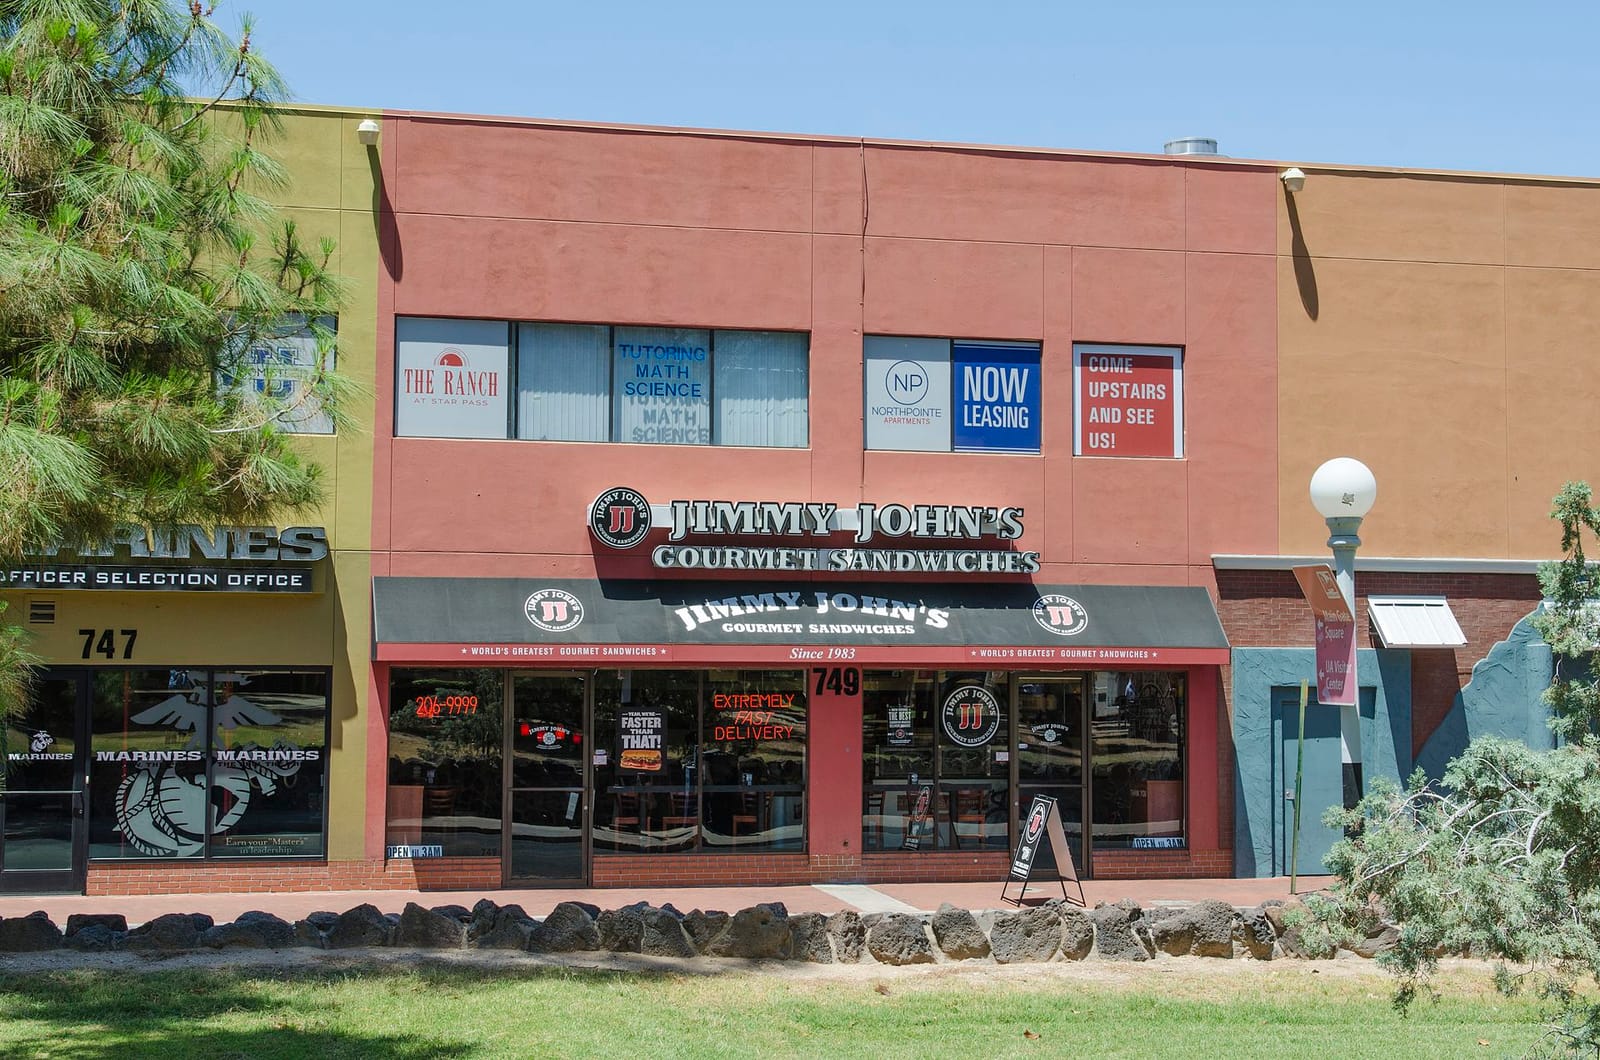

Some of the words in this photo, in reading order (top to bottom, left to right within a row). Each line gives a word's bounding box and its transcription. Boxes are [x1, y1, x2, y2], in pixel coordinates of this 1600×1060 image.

[619, 344, 705, 362] TUTORING
[636, 364, 689, 379] MATH
[1088, 356, 1133, 374] COME
[404, 369, 434, 394] THE
[444, 370, 498, 397] RANCH
[625, 382, 701, 398] SCIENCE
[894, 373, 923, 392] NP
[964, 366, 1029, 403] NOW
[1088, 381, 1166, 400] UPSTAIRS
[462, 399, 488, 407] PASS
[871, 406, 942, 418] NORTHPOINTE
[963, 404, 1029, 429] LEASING
[1088, 407, 1121, 423] AND
[1126, 407, 1154, 425] SEE
[883, 417, 930, 425] APARTMENTS
[1088, 432, 1115, 449] US!
[596, 492, 619, 518] JIMMY
[621, 492, 647, 518] JOHN'S
[609, 505, 635, 533] JJ
[669, 500, 837, 541] JIMMY
[855, 502, 1024, 543] JOHN'S
[652, 545, 817, 570] GOURMET
[828, 549, 1040, 573] SANDWICHES
[96, 572, 217, 586] SELECTION
[227, 574, 303, 587] OFFICE
[541, 601, 567, 622] JJ
[675, 591, 801, 631] JIMMY
[814, 591, 950, 629] JOHN'S
[722, 622, 803, 633] GOURMET
[809, 623, 916, 635] SANDWICHES
[78, 629, 138, 659] 747
[471, 647, 509, 656] WORLD'S
[512, 647, 554, 656] GREATEST
[560, 647, 599, 656] GOURMET
[602, 647, 656, 656] SANDWICHES
[789, 647, 824, 659] Since
[827, 648, 856, 660] 1983
[980, 649, 1014, 657] WORLD'S
[1017, 649, 1055, 657] GREATEST
[1060, 650, 1096, 658] GOURMET
[1099, 650, 1148, 659] SANDWICHES
[812, 667, 860, 696] 749
[415, 695, 478, 716] 206-9999
[714, 693, 795, 709] EXTREMELY
[946, 689, 969, 716] JIMMY
[972, 690, 997, 716] JOHN'S
[621, 716, 662, 728] FASTER
[734, 710, 774, 725] FAST
[888, 712, 898, 721] THE
[959, 703, 983, 730] JJ
[714, 726, 794, 741] DELIVERY
[621, 735, 662, 749] THAT!
[8, 753, 73, 761] MARINES
[96, 751, 202, 762] MARINES
[216, 750, 321, 761] MARINES
[1135, 838, 1156, 849] OPEN
[1166, 838, 1184, 849] 3AM
[386, 846, 408, 858] OPEN
[422, 846, 441, 858] 3AM
